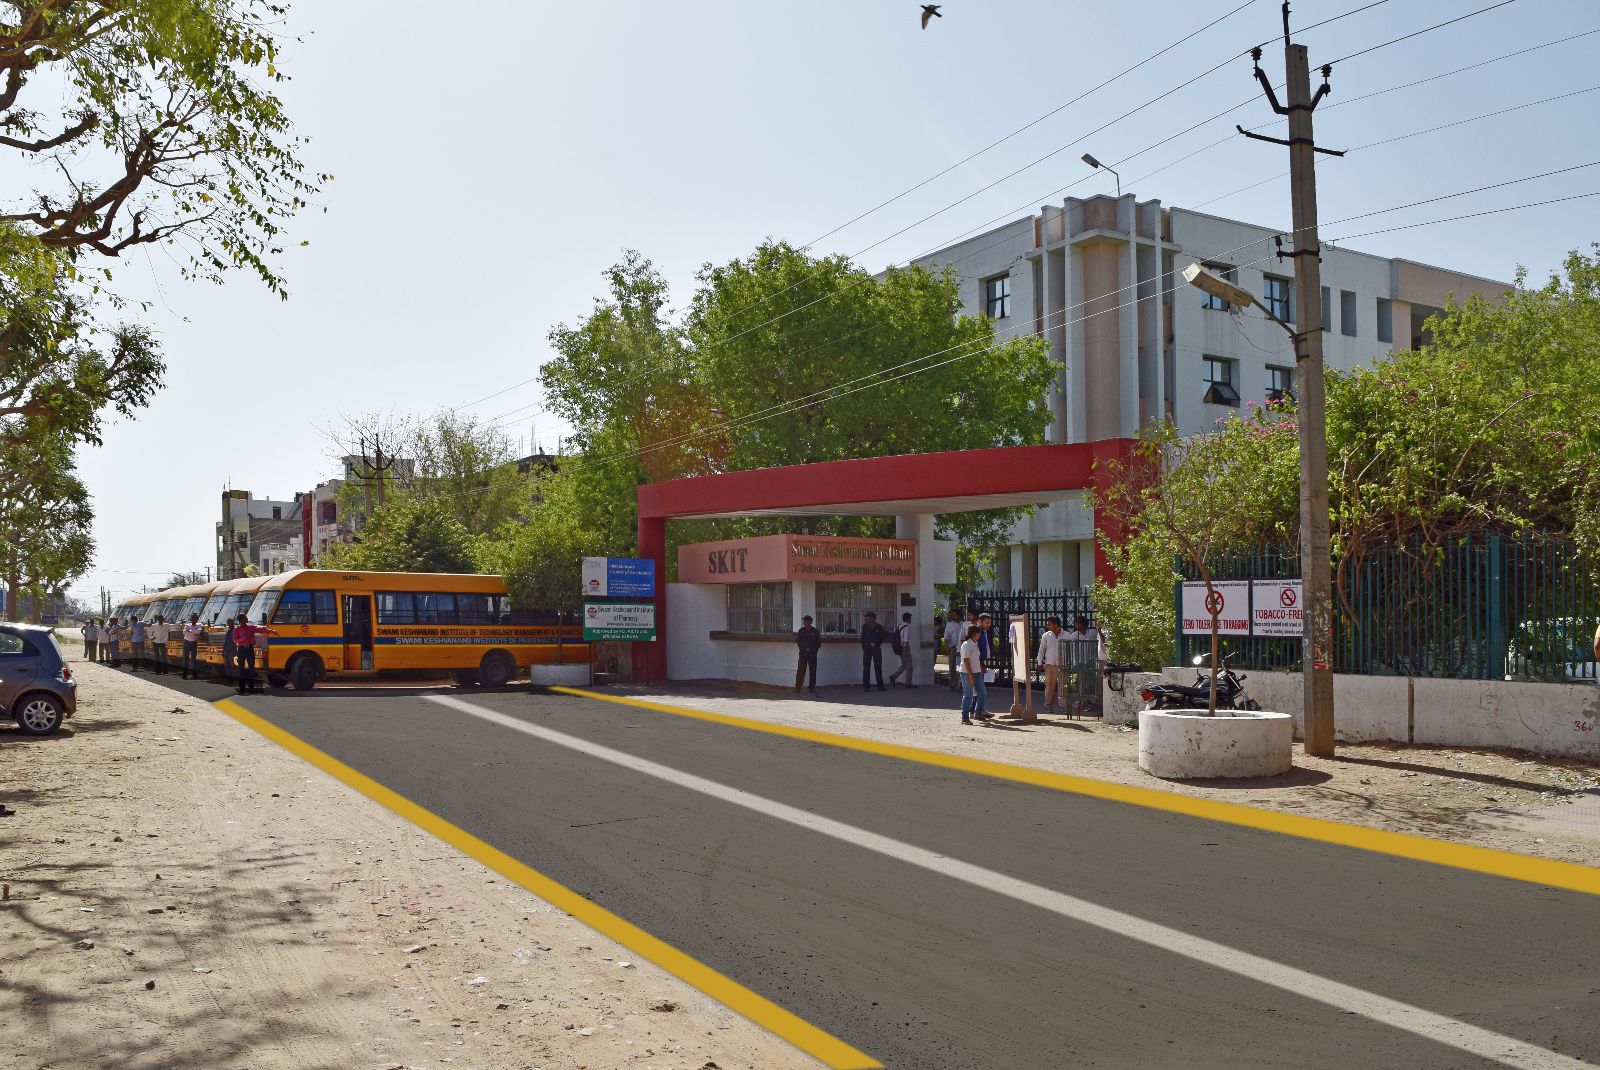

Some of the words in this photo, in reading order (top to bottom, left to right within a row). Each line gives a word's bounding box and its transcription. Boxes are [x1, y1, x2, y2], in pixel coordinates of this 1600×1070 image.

[709, 548, 748, 573] SKIT
[1183, 619, 1195, 630] ZERO
[377, 628, 399, 636] SWAMI
